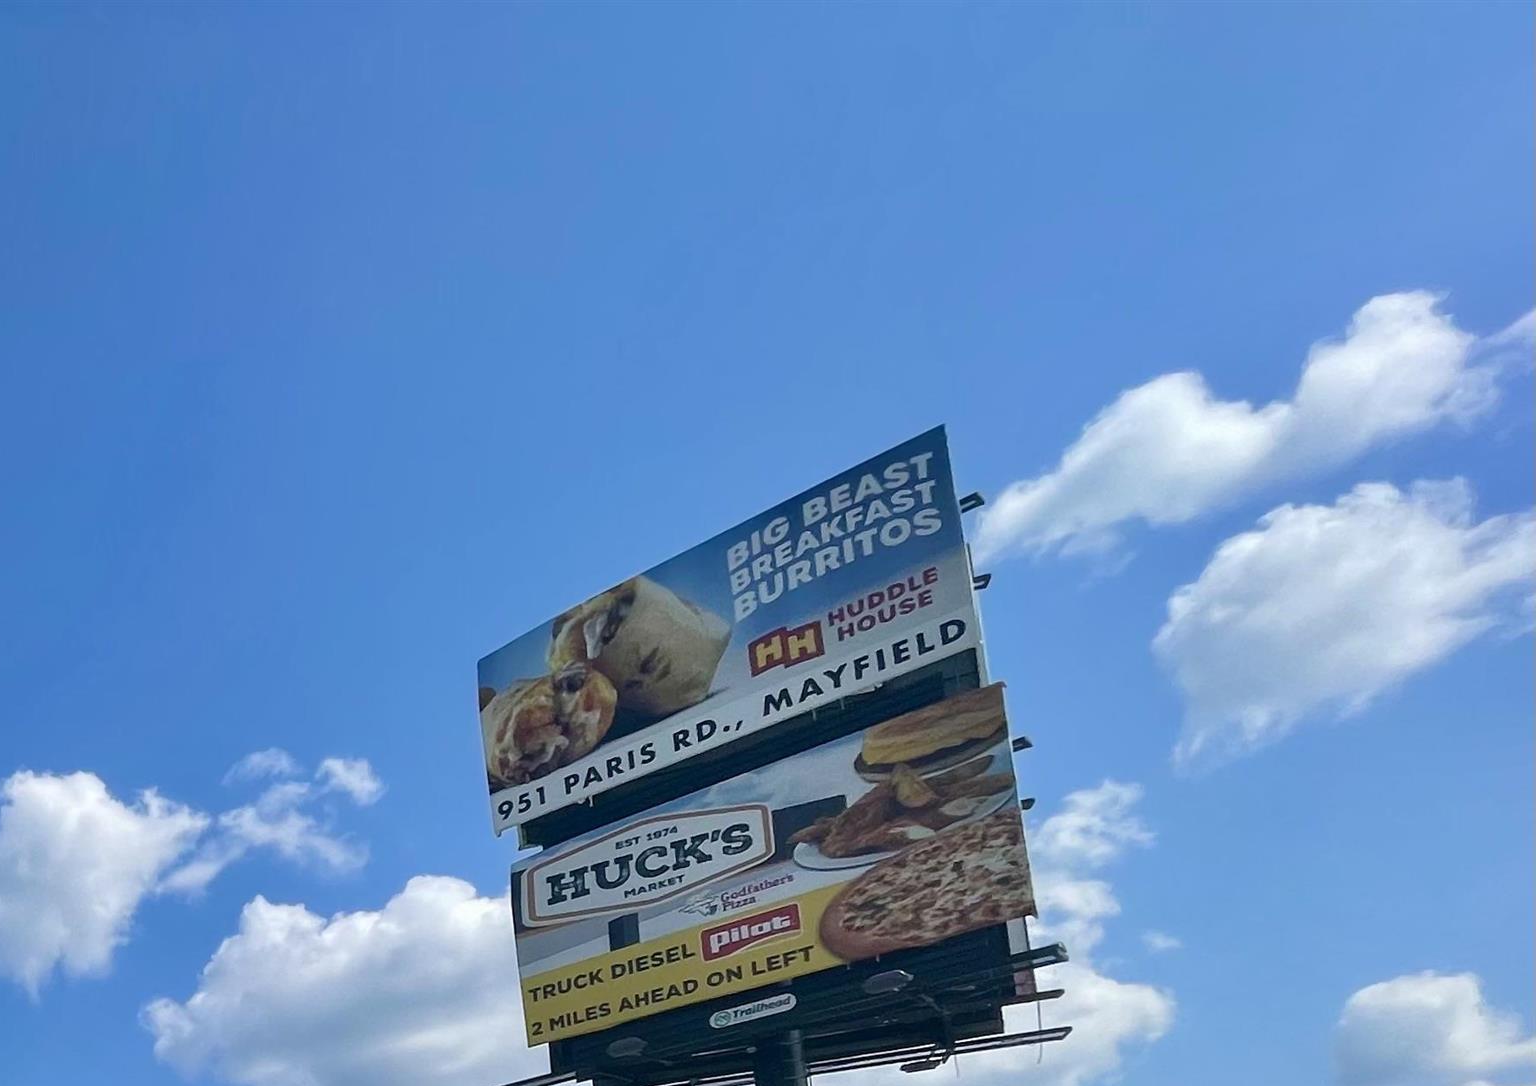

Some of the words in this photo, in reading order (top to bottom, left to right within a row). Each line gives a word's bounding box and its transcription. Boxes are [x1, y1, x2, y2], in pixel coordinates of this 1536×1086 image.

[727, 516, 789, 571] BIG
[802, 452, 933, 527] BEAST
[730, 480, 936, 595] BREAKFAST
[733, 508, 942, 623] BURRITOS
[828, 567, 938, 626] HUDDLE
[838, 590, 933, 641] HOUSE
[497, 786, 546, 821] 951
[564, 743, 656, 795] PARIS
[672, 719, 743, 752] RD.,
[763, 619, 966, 717] MAYFIELD
[546, 823, 753, 906] HUCK'S
[615, 835, 641, 850] EST
[624, 874, 685, 899] MARKET
[722, 896, 756, 912] Pizza
[529, 968, 603, 1003] TRUCK
[611, 944, 695, 980] DIESEL
[532, 1021, 544, 1036] 2
[550, 1003, 611, 1032] MILES
[619, 979, 698, 1013] AHEAD
[706, 965, 743, 987] ON
[751, 945, 814, 976] LEFT
[733, 995, 791, 1018] Trailhead
